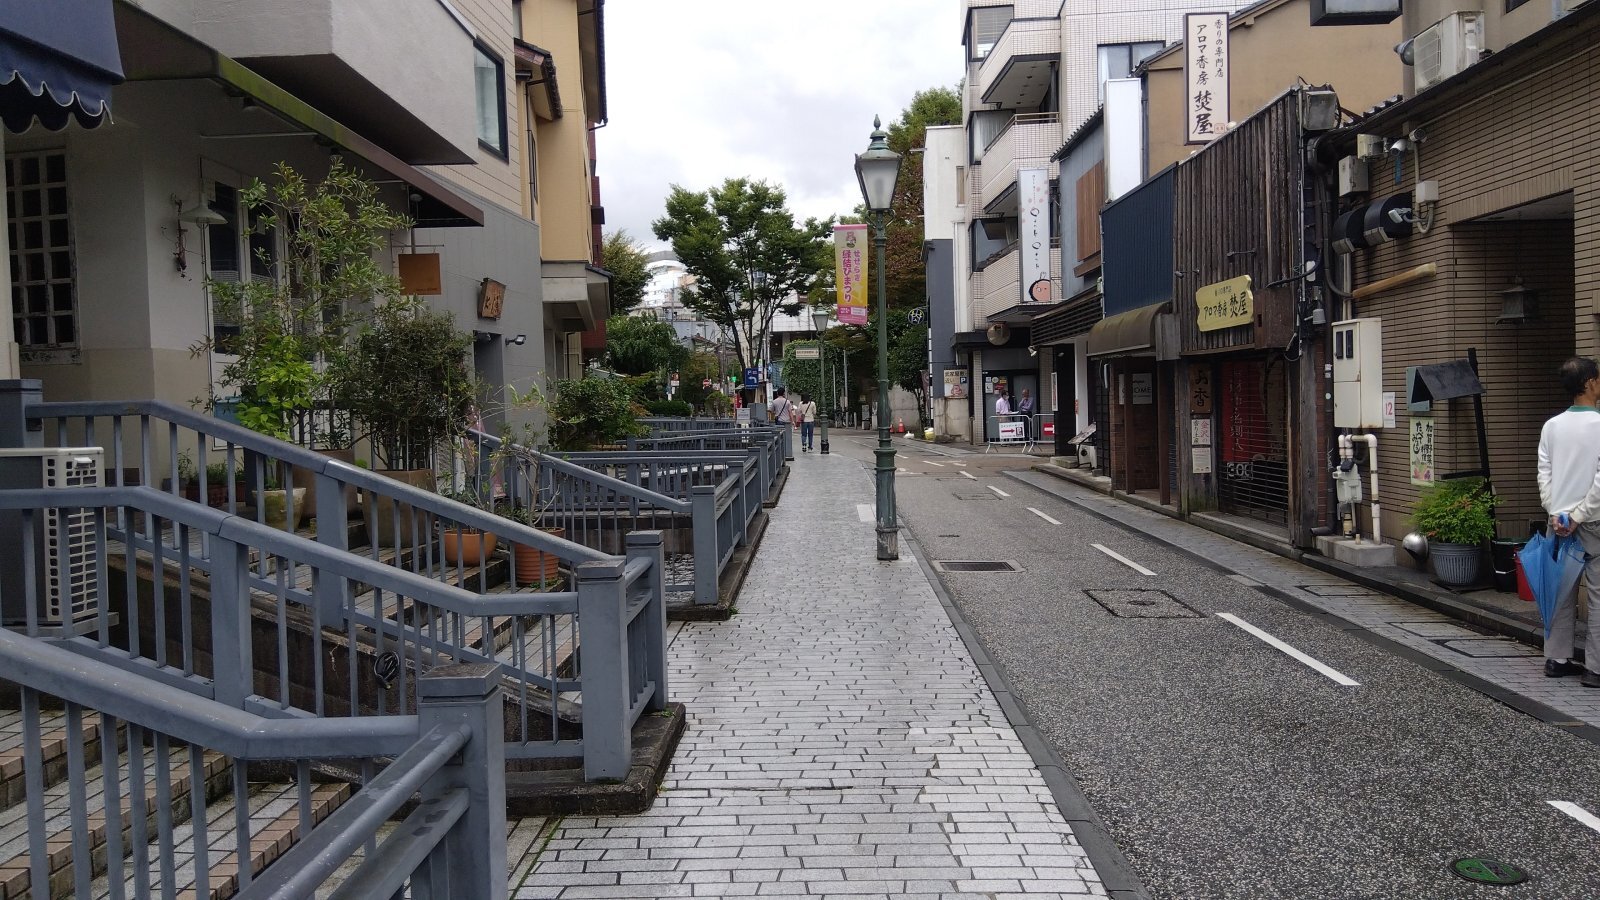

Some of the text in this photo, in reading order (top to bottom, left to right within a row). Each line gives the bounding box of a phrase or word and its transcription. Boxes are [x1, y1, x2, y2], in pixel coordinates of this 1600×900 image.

[1215, 18, 1224, 78] 香りの専門店
[842, 249, 853, 303] 縁結びまつり
[1193, 369, 1209, 407] お香
[1385, 402, 1393, 416] 12
